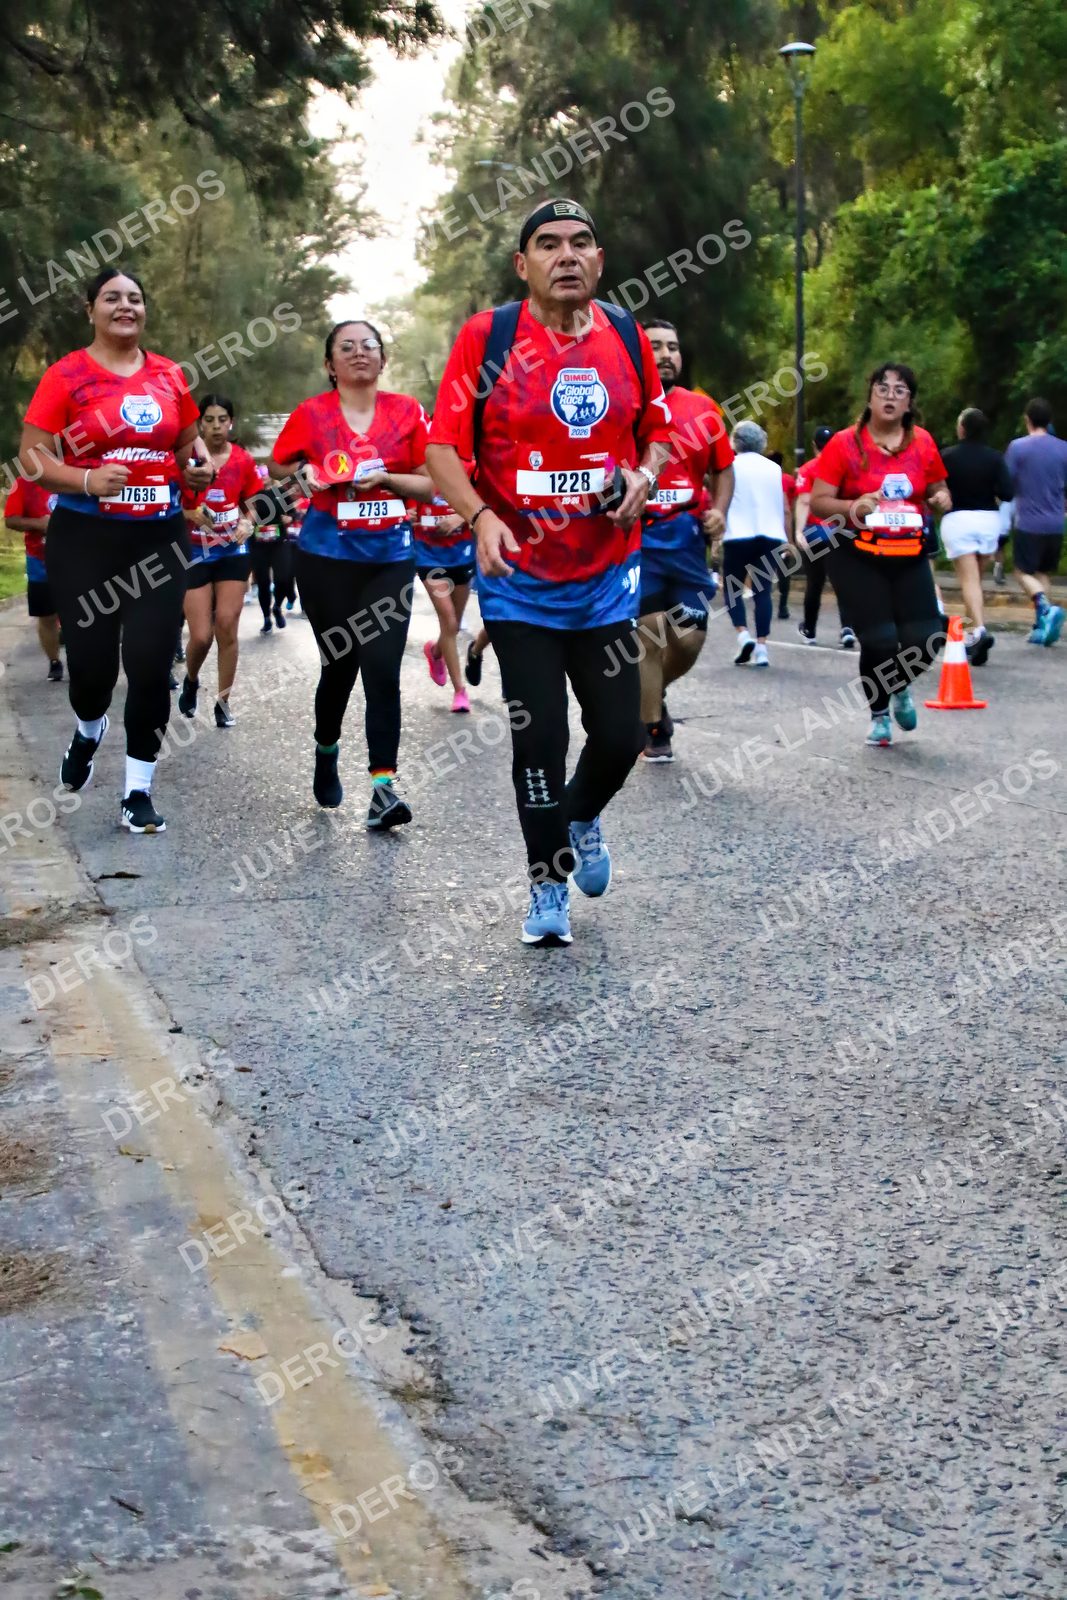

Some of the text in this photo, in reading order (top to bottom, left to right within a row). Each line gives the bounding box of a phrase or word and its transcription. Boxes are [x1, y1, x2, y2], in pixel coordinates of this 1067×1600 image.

[563, 374, 594, 382] BIMBO
[565, 385, 594, 396] Global
[559, 394, 584, 405] Race
[571, 428, 589, 436] 2026
[550, 471, 590, 493] 1228
[121, 487, 156, 502] 17636
[359, 502, 388, 517] 2733
[884, 513, 906, 525] 1563
